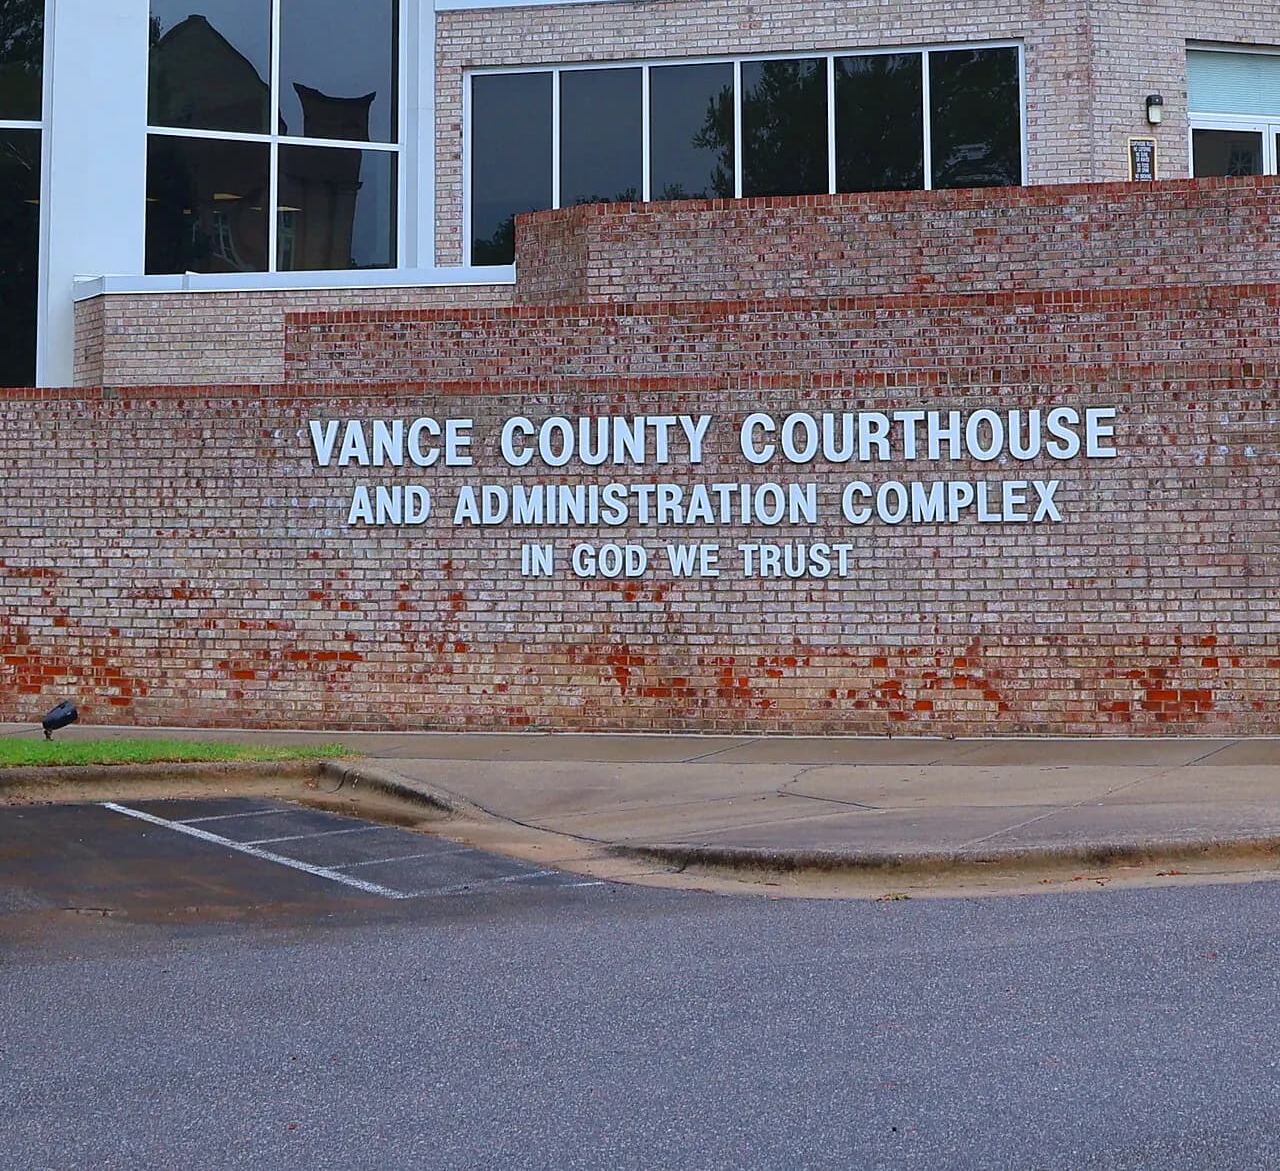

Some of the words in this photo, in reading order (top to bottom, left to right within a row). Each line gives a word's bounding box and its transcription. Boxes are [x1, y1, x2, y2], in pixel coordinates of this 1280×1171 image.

[308, 417, 473, 467] VANCE
[500, 415, 712, 466] COUNTY
[740, 407, 1118, 464] COURTHOUSE
[346, 485, 431, 525] AND
[453, 482, 818, 526] ADMINISTRATION
[842, 480, 1063, 524] COMPLEX
[521, 544, 554, 577] IN
[572, 543, 648, 578] GOD
[666, 544, 720, 577] WE
[737, 542, 854, 577] TRUST
